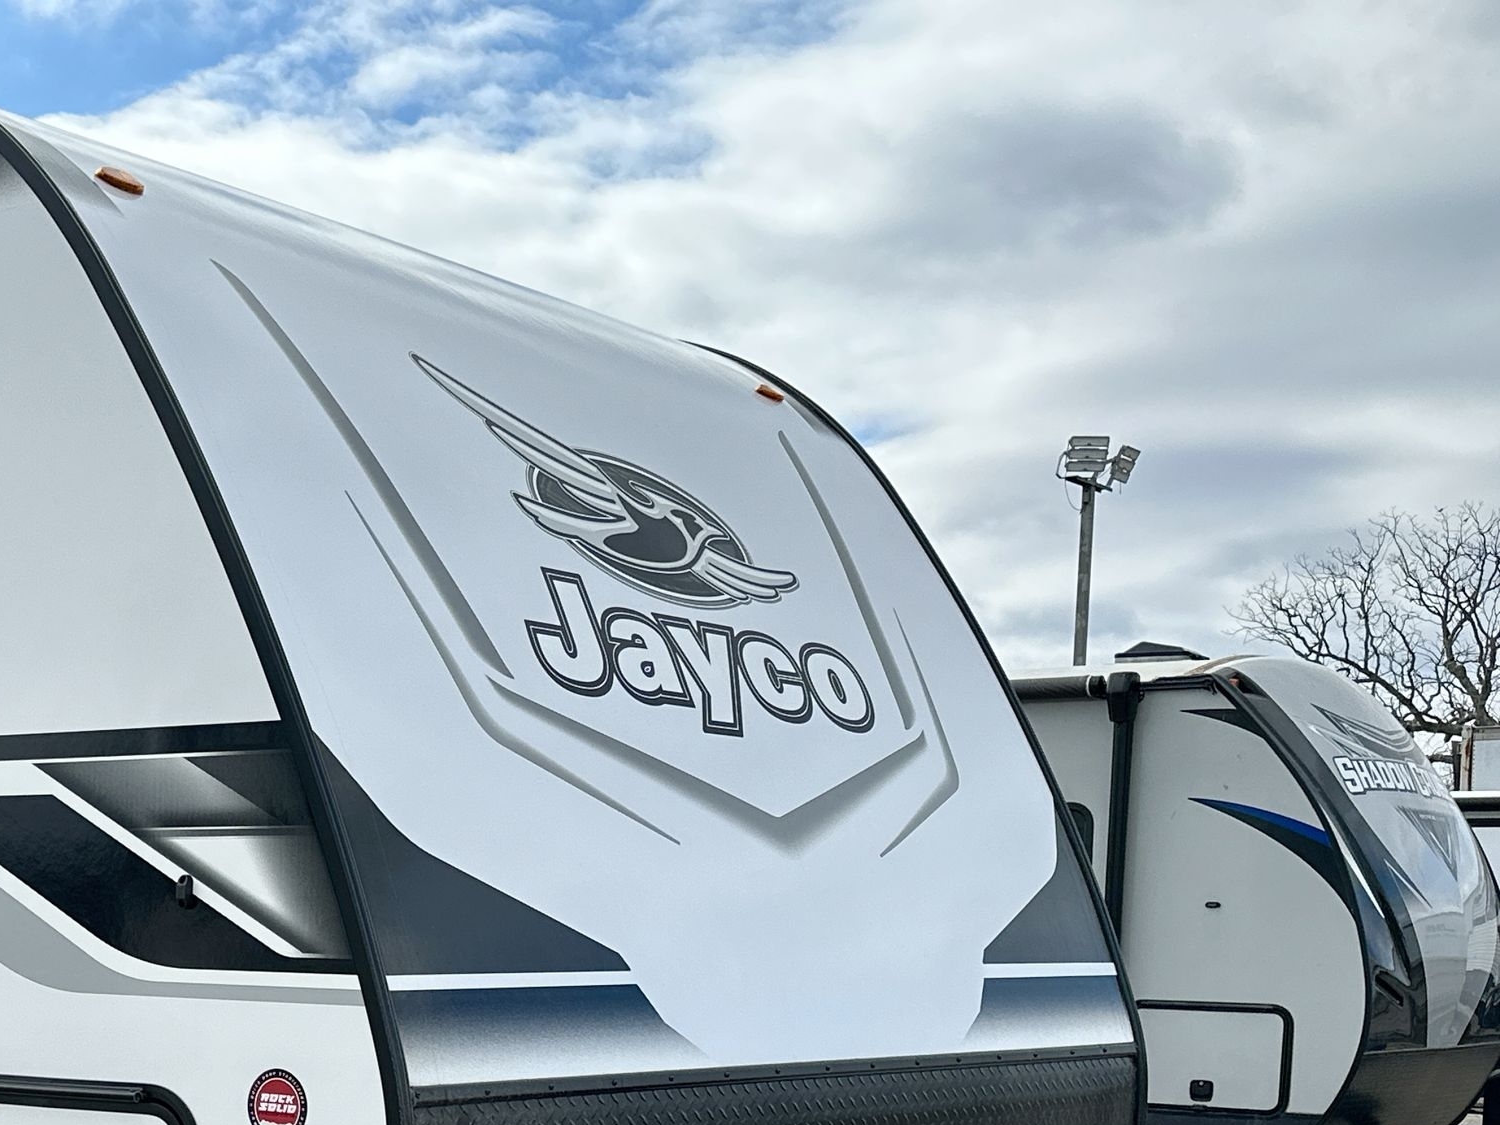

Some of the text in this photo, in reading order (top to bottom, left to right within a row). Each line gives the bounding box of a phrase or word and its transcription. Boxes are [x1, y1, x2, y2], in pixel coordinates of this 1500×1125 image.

[524, 566, 876, 738] Jayco
[1333, 756, 1419, 795] SHADOW
[258, 1102, 297, 1114] SOLID
[260, 1093, 296, 1104] ROCK
